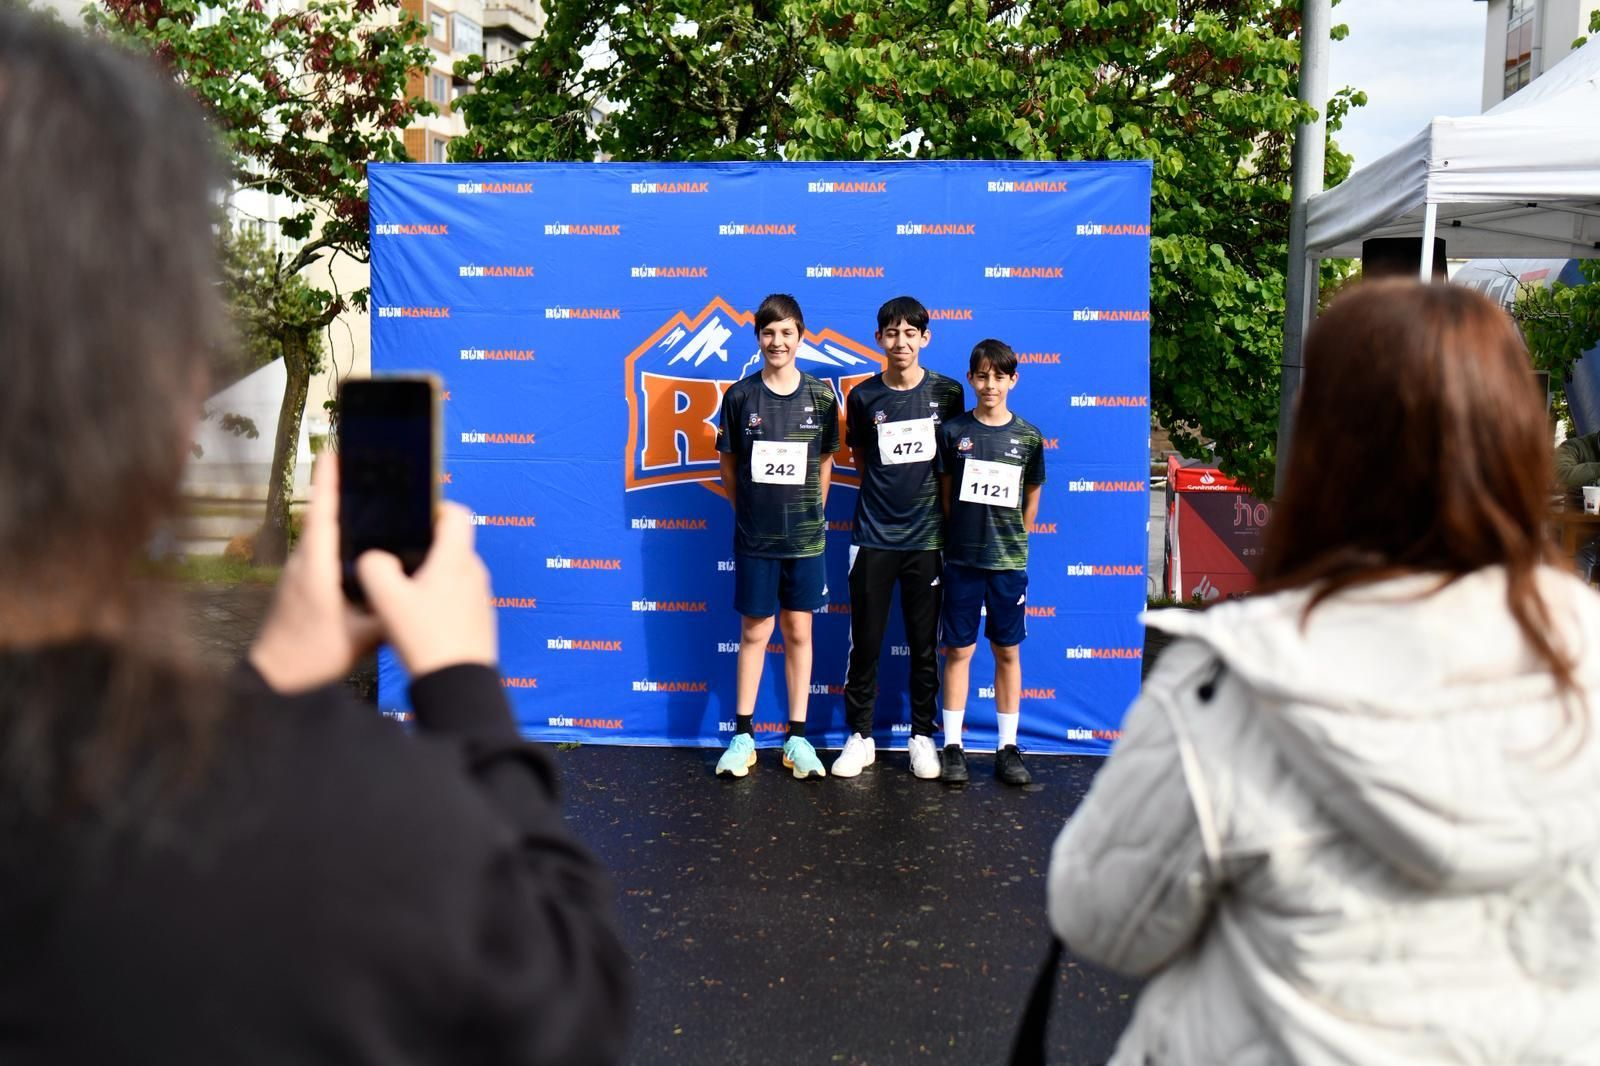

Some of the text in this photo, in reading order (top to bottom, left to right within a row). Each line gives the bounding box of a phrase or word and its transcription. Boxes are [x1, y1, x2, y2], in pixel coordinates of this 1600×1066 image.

[893, 441, 924, 456] 472
[765, 463, 795, 476] 242
[971, 482, 1009, 498] 1121
[468, 512, 536, 527] UNMANIAK
